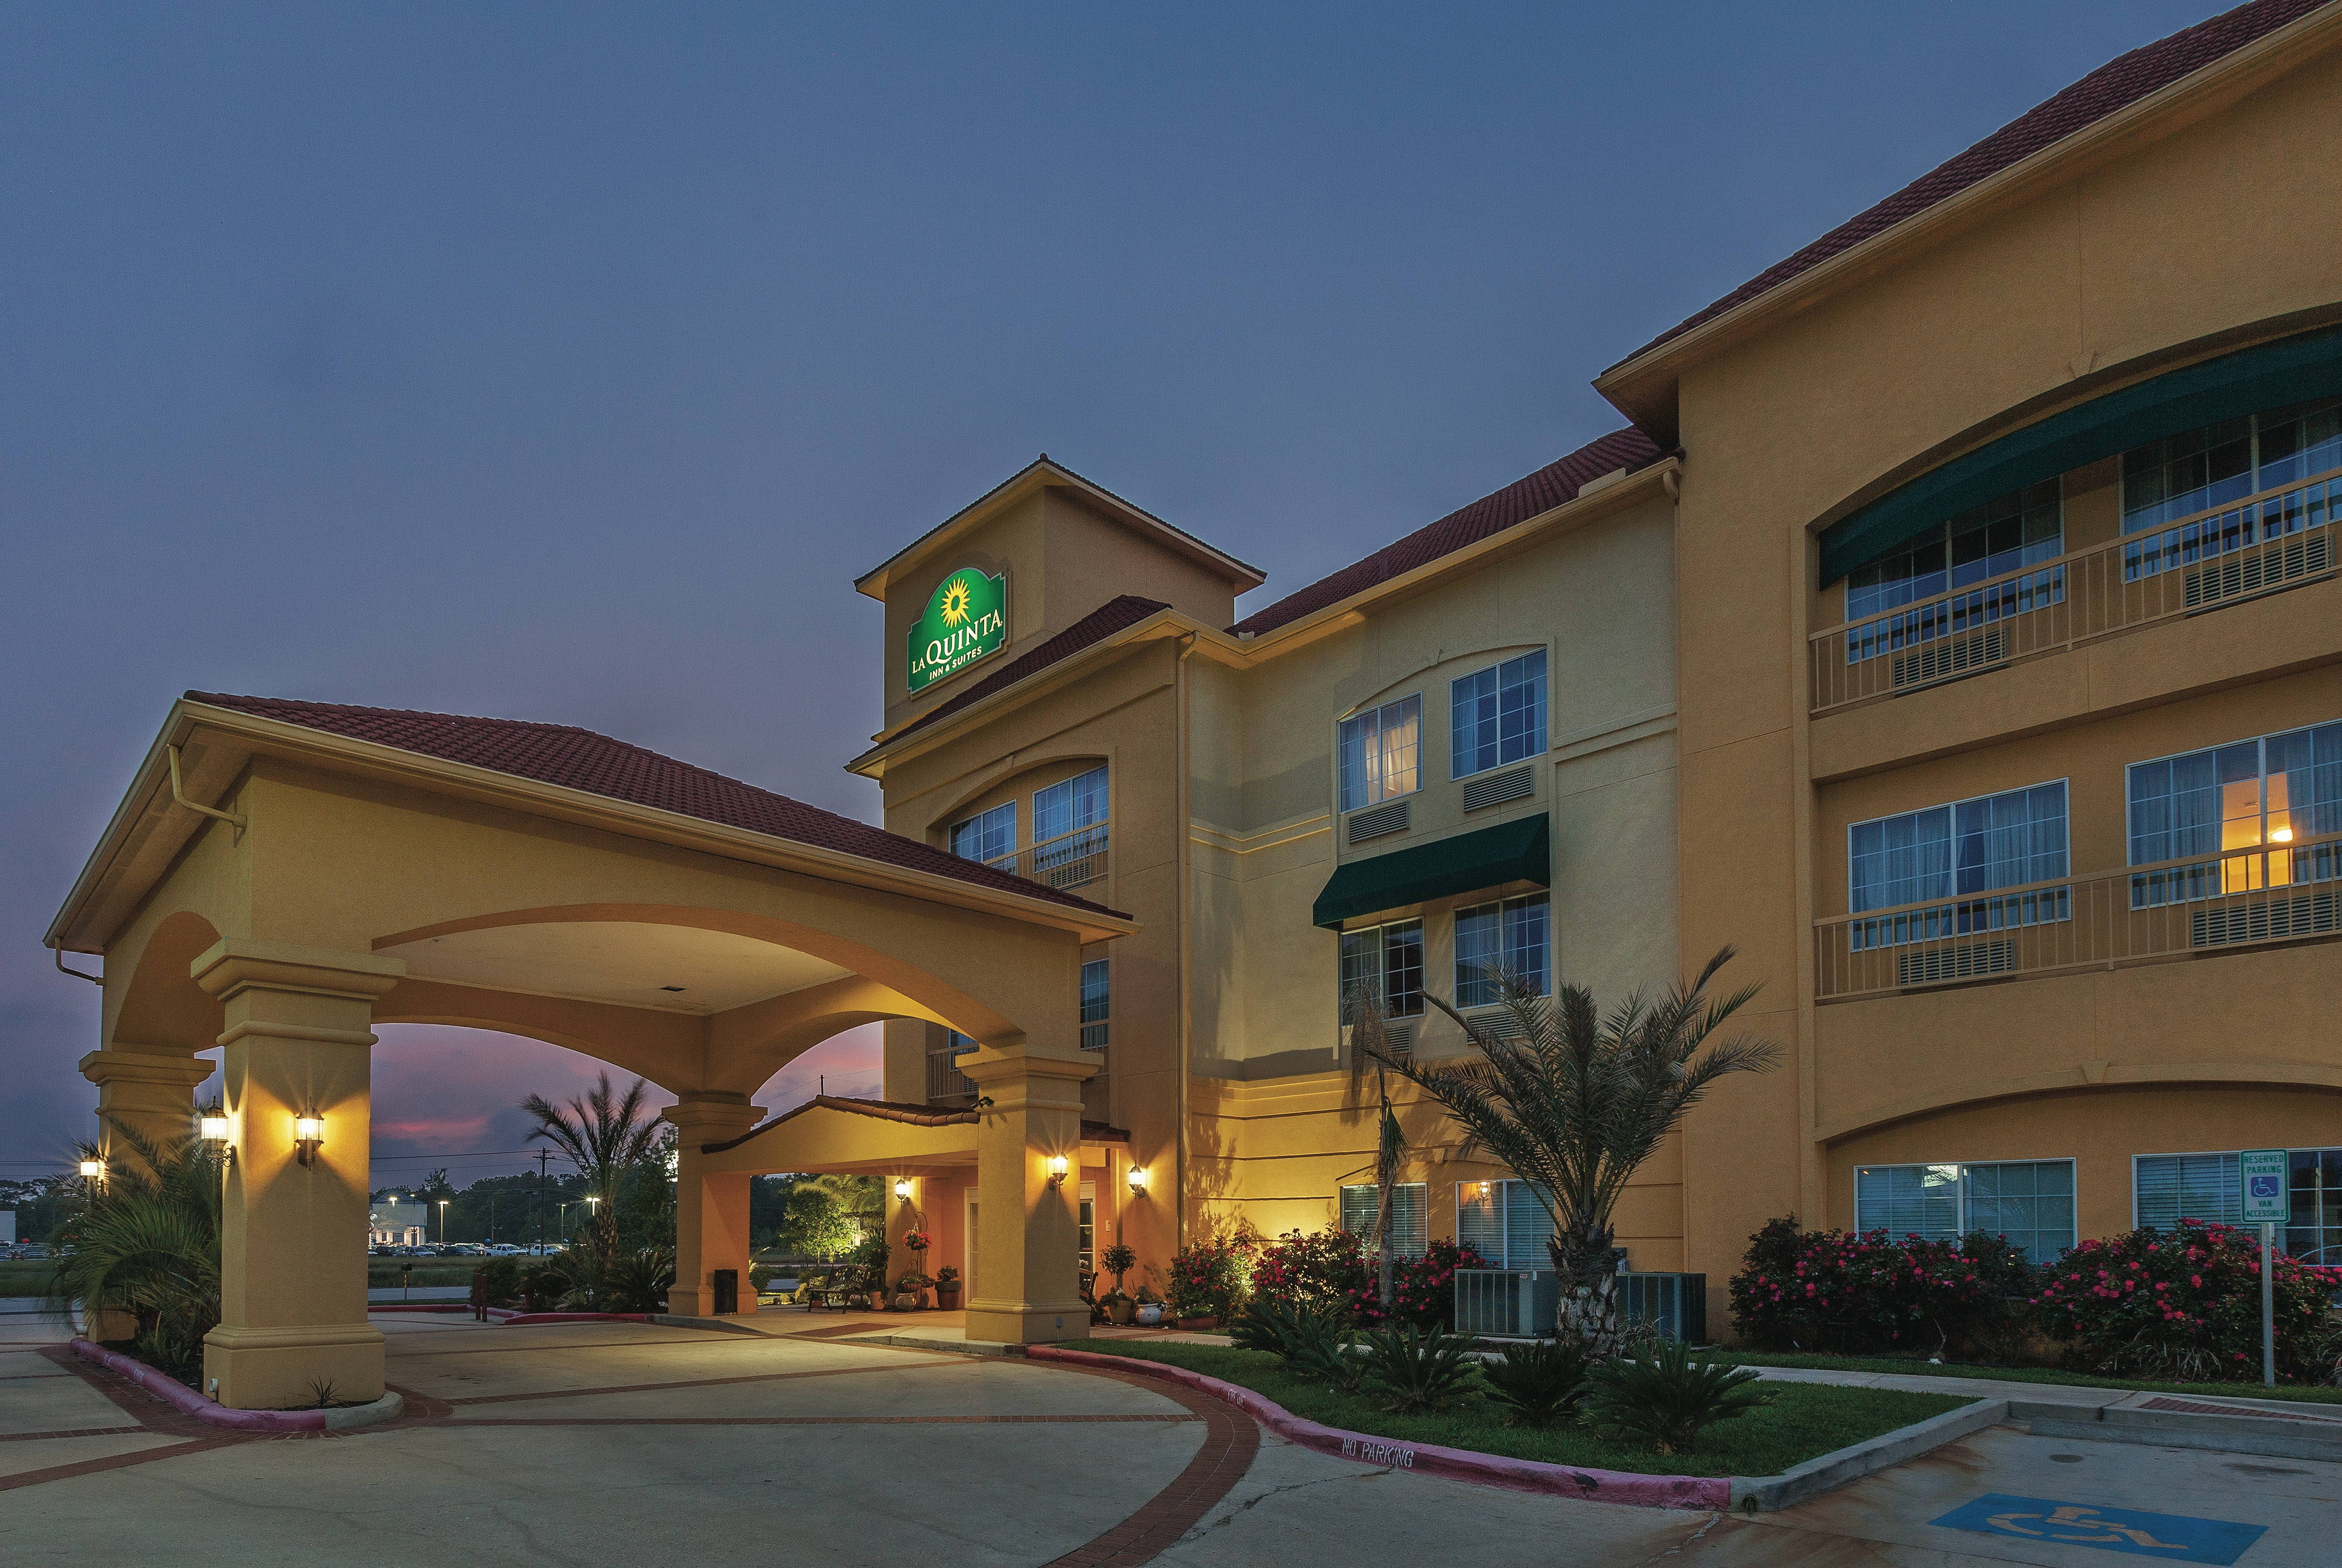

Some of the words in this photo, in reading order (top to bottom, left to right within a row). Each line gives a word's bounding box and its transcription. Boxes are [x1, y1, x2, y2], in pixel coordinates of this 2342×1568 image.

[912, 657, 926, 674] LA
[926, 609, 1003, 664] QUINTA
[929, 666, 943, 681] INN
[952, 646, 982, 669] SUITES
[2245, 1154, 2284, 1163] RESERVED
[2247, 1165, 2282, 1174] PARKING
[1342, 1438, 1357, 1456] NO
[1361, 1442, 1414, 1467] PARKING
